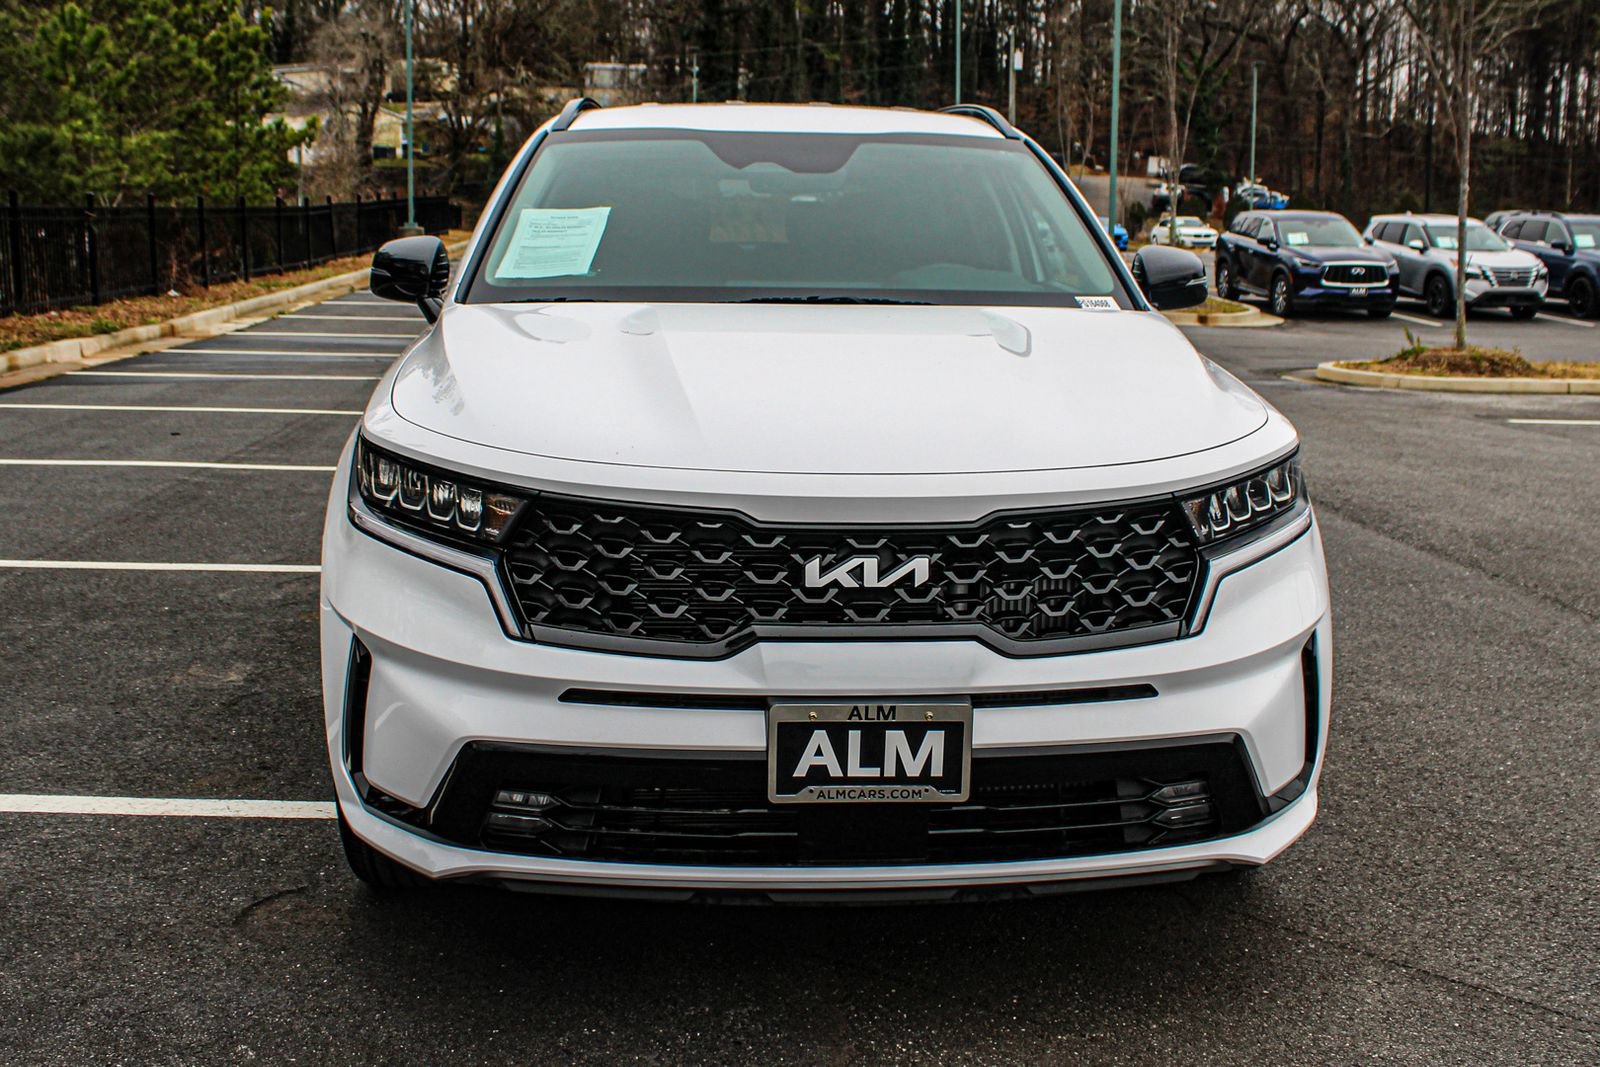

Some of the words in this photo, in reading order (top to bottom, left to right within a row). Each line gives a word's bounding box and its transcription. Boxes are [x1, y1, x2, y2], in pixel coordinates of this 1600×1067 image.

[805, 557, 929, 587] KIA
[847, 705, 897, 721] ALM
[792, 729, 945, 777] ALM
[816, 789, 922, 799] ALMCARS.COM
